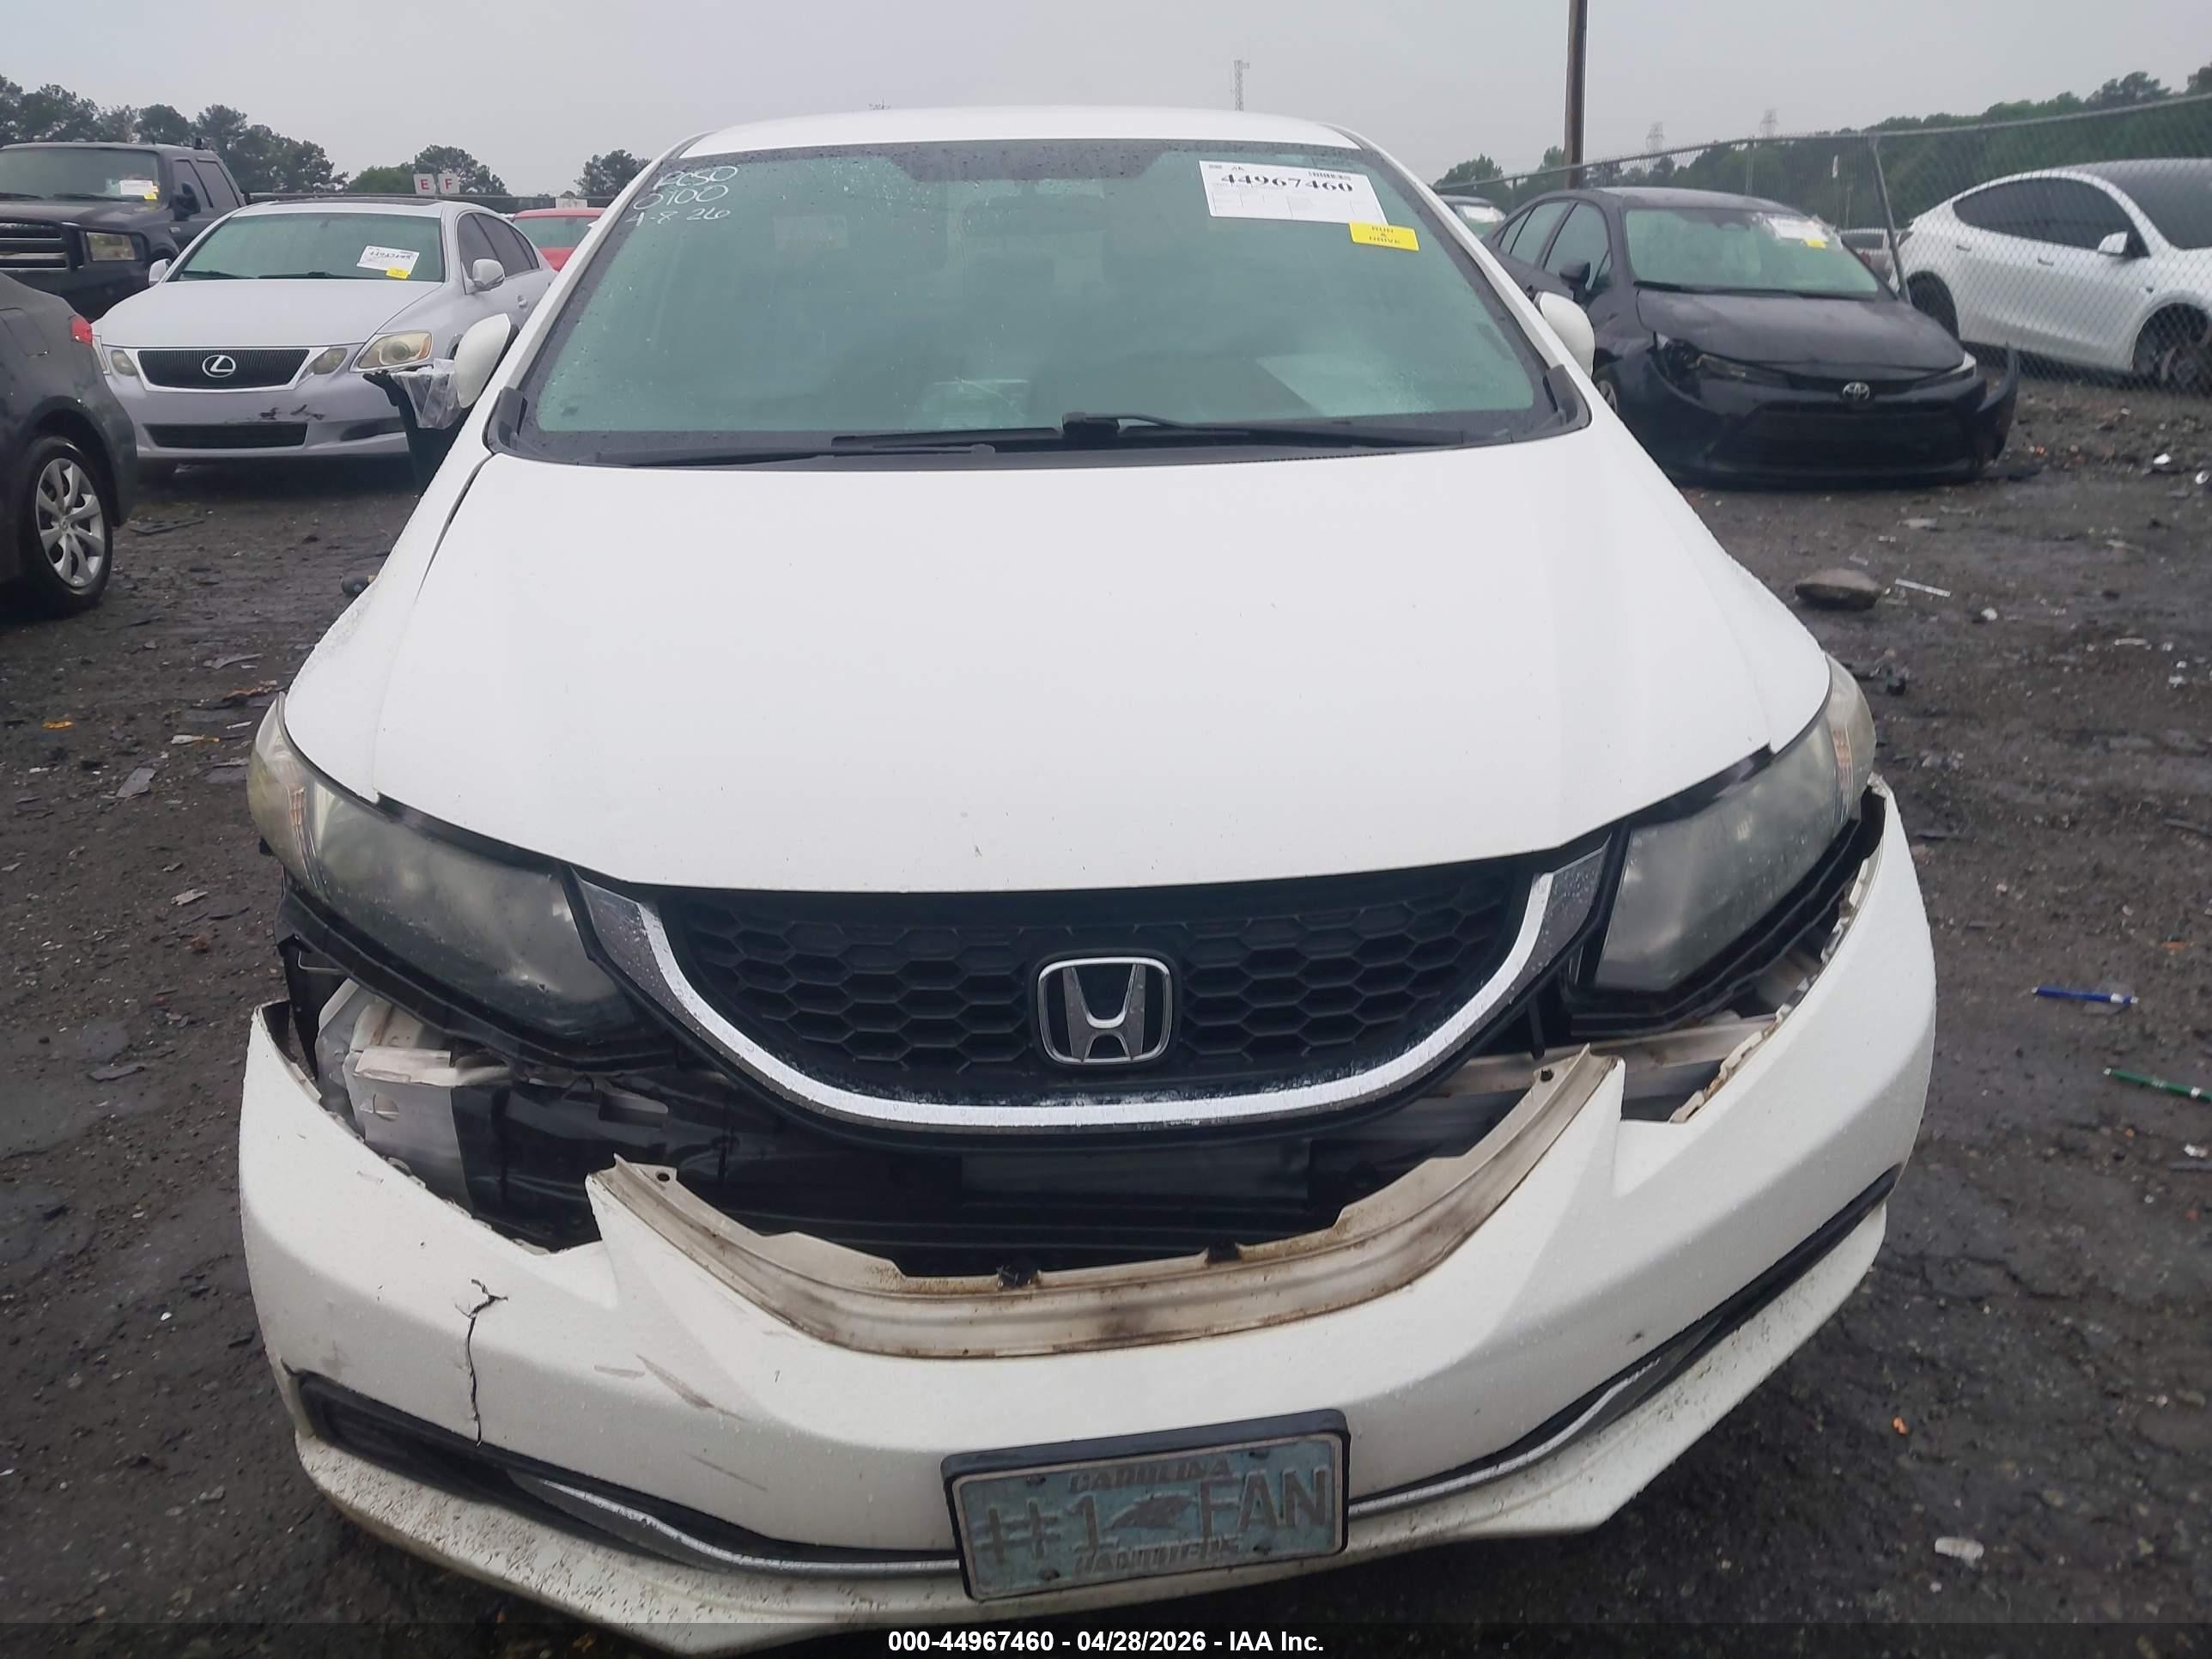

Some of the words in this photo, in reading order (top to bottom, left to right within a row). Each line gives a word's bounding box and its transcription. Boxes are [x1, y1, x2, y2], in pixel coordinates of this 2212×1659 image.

[420, 179, 430, 190] E
[445, 178, 453, 190] F
[1221, 173, 1353, 192] 44967460
[1069, 1457, 1231, 1492] CAROLINA
[970, 1491, 1118, 1565] #1
[1194, 1463, 1330, 1543] FAN
